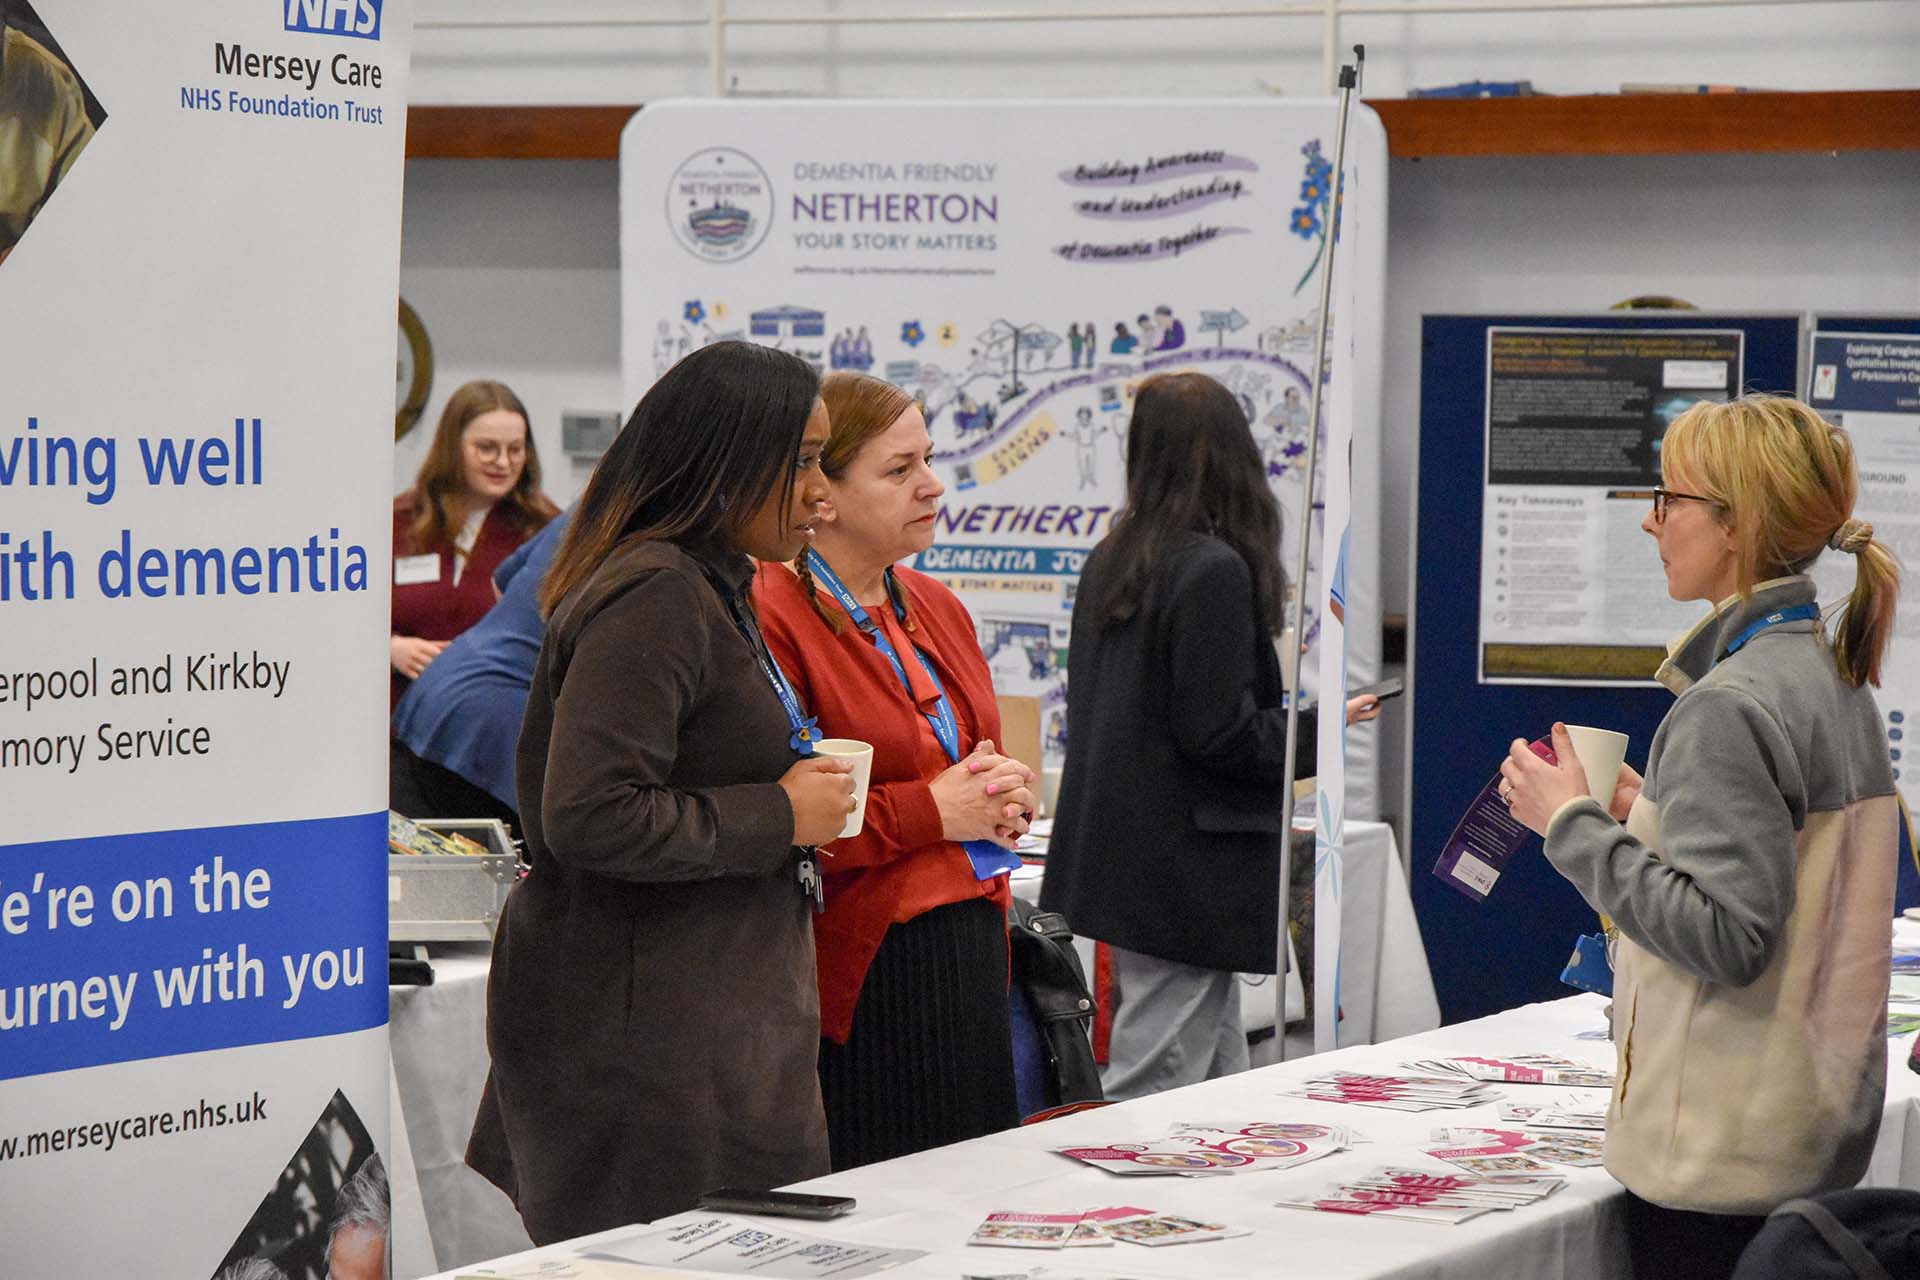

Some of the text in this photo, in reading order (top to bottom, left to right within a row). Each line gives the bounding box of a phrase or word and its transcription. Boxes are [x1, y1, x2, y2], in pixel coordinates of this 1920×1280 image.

[287, 0, 376, 34] NHS
[215, 42, 381, 91] Mersey Care
[182, 87, 382, 124] NHS Foundation Trust
[794, 163, 995, 182] DEMENTIA FRIENDLY
[1074, 160, 1140, 183] Building
[794, 194, 997, 223] NETHERTON
[1080, 196, 1117, 212] and
[795, 233, 996, 251] YOUR STORY MATTERS
[1059, 241, 1077, 259] of
[1080, 240, 1153, 259] Dementia
[138, 419, 261, 486] well
[99, 528, 367, 598] dementia
[923, 548, 1087, 572] DEMENTIA JO
[841, 593, 857, 610] NHS
[111, 654, 171, 695] and
[188, 651, 290, 698] Kirkby
[2, 718, 210, 773] mory Service
[0, 856, 271, 935] e’re on the
[153, 943, 264, 1008] with
[282, 946, 365, 1009] you
